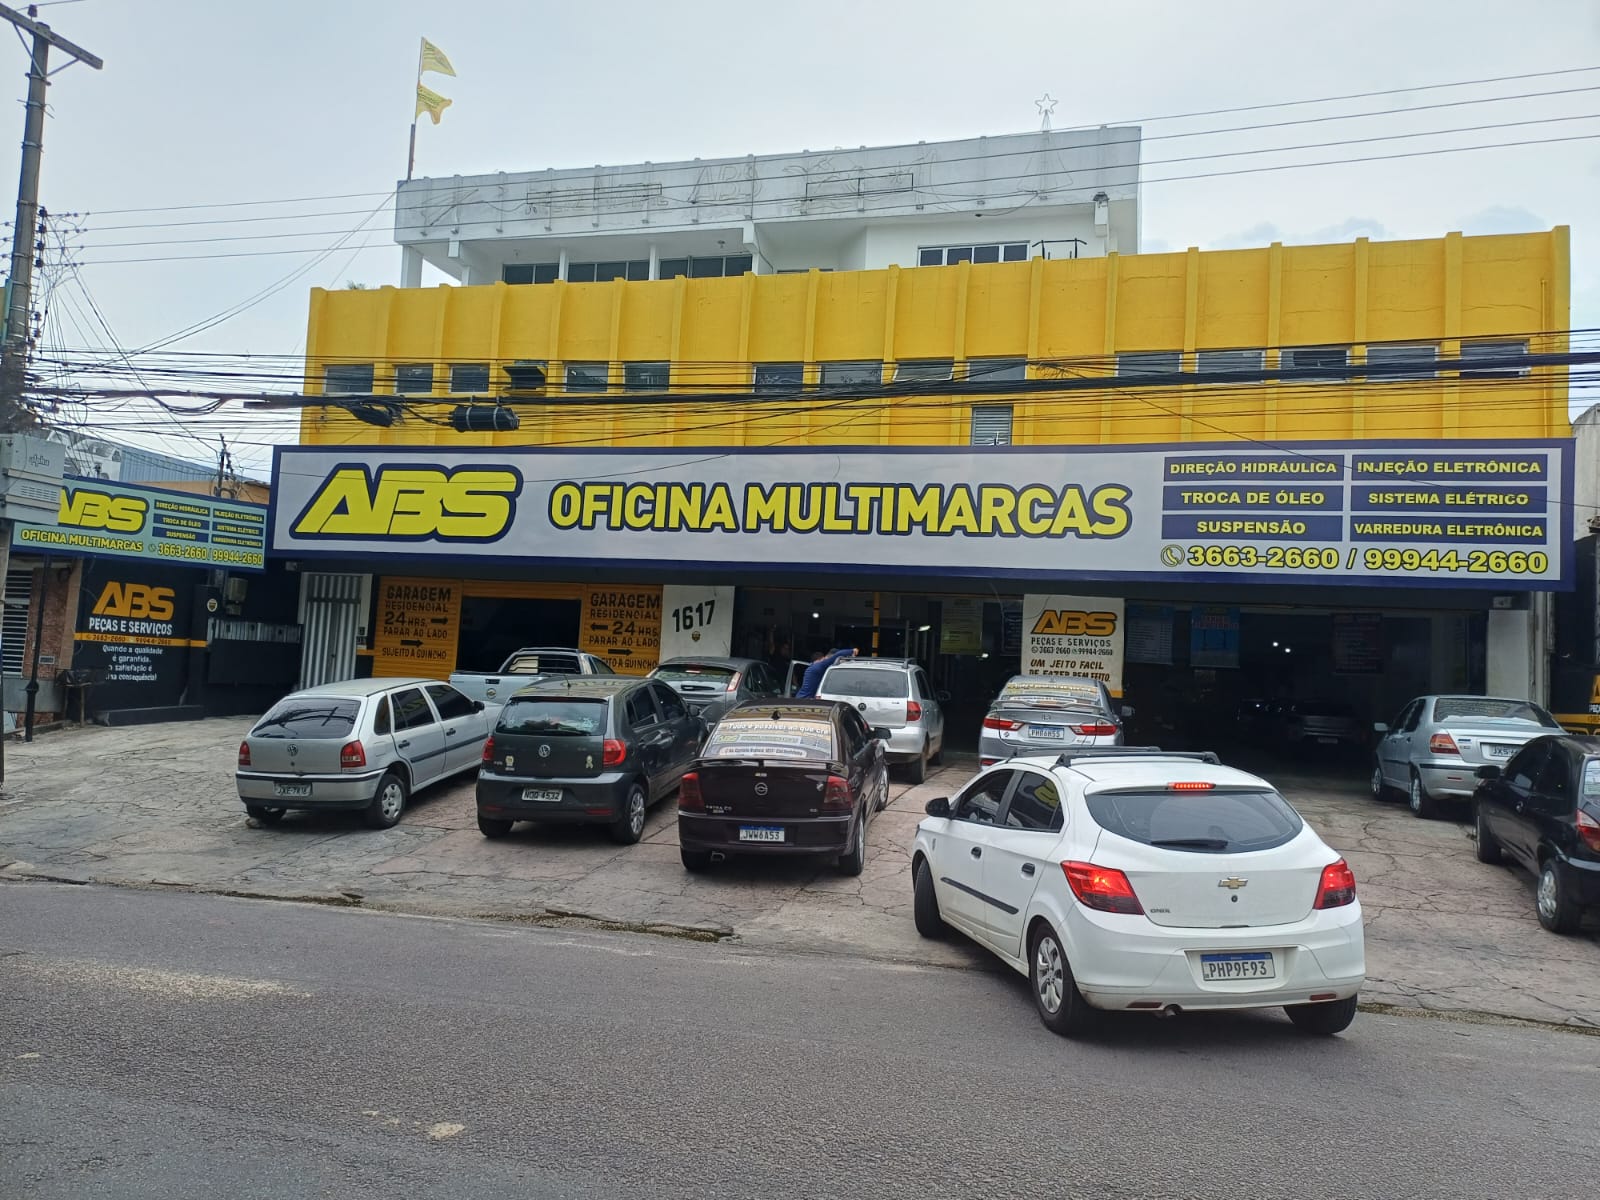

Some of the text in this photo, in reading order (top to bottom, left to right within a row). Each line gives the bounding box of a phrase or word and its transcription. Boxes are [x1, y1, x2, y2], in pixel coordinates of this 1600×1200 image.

[1169, 461, 1337, 475] DIREÇÃO HIDRÁULICA
[1357, 460, 1541, 475] INJEÇÃO ELETRÔNICA
[291, 464, 522, 542] ABS
[1181, 489, 1325, 505] TROCA DE ÓLEO
[1368, 492, 1529, 505] SISTEMA ELÉTRICO
[549, 482, 1133, 538] OFICINA MULTIMARCAS
[1197, 520, 1306, 535] SUSPENSÃO
[1354, 523, 1543, 537] VARREDURA ELETRÔNICA
[21, 529, 144, 551] OFICINA MULTIMARCAS
[158, 543, 208, 560] 3663-2660
[212, 549, 263, 565] 99944-2660
[1187, 545, 1339, 570] 3663-2660
[1363, 548, 1549, 574] 99944-2660
[92, 580, 175, 620] ABS
[387, 585, 452, 602] GARAGEM
[590, 592, 660, 609] GARAGEM
[384, 600, 449, 612] RESIDENCIAL
[384, 611, 406, 625] 24
[590, 609, 658, 620] RESIDENCIAL
[671, 600, 716, 633] 1617
[88, 617, 173, 636] PEÇAS E SERVIÇOS
[612, 621, 636, 636] 24
[1030, 609, 1118, 637] ABS
[383, 626, 448, 639] PARAR AO LADO
[589, 635, 659, 648] PARAR AO LADO
[1031, 637, 1112, 648] PEÇAS E SERVIÇOS
[102, 645, 128, 653] Quando
[134, 646, 163, 655] qualidade
[382, 647, 447, 660] SUJEITO A GUINCHO
[618, 658, 624, 668] A
[624, 658, 657, 670] GUINCHO
[1030, 659, 1104, 670] UM JEITO FACIL
[1208, 961, 1267, 978] PHP9F93
